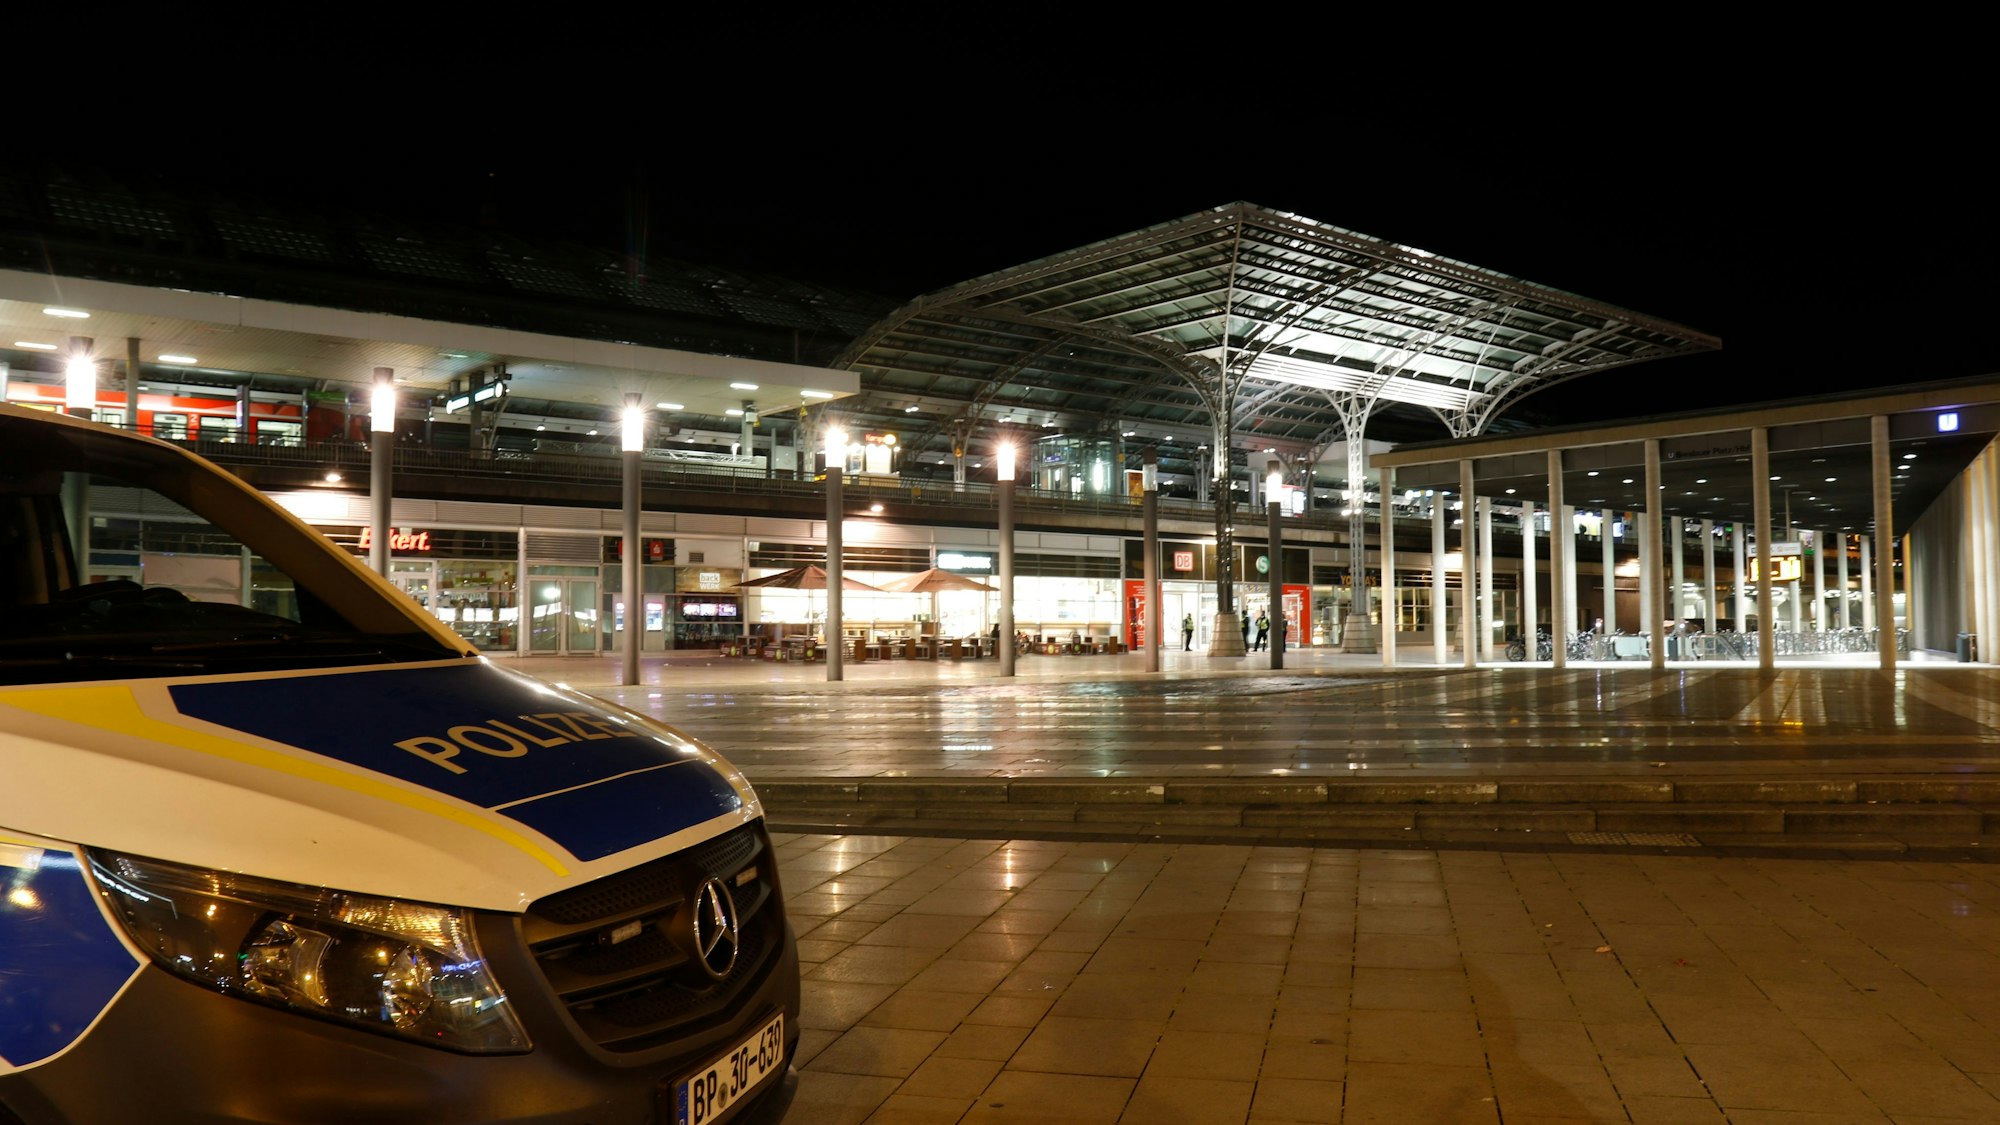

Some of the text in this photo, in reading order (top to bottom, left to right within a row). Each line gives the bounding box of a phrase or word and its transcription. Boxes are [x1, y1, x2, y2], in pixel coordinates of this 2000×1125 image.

[190, 414, 196, 422] 2
[1939, 413, 1958, 431] U
[359, 526, 431, 550] Ekert.
[1175, 554, 1191, 568] DB
[1257, 557, 1268, 571] S
[700, 573, 719, 582] back
[1341, 575, 1376, 586] YOA'S
[393, 711, 641, 775] POLIZE
[694, 1020, 780, 1125] BP 30-639
